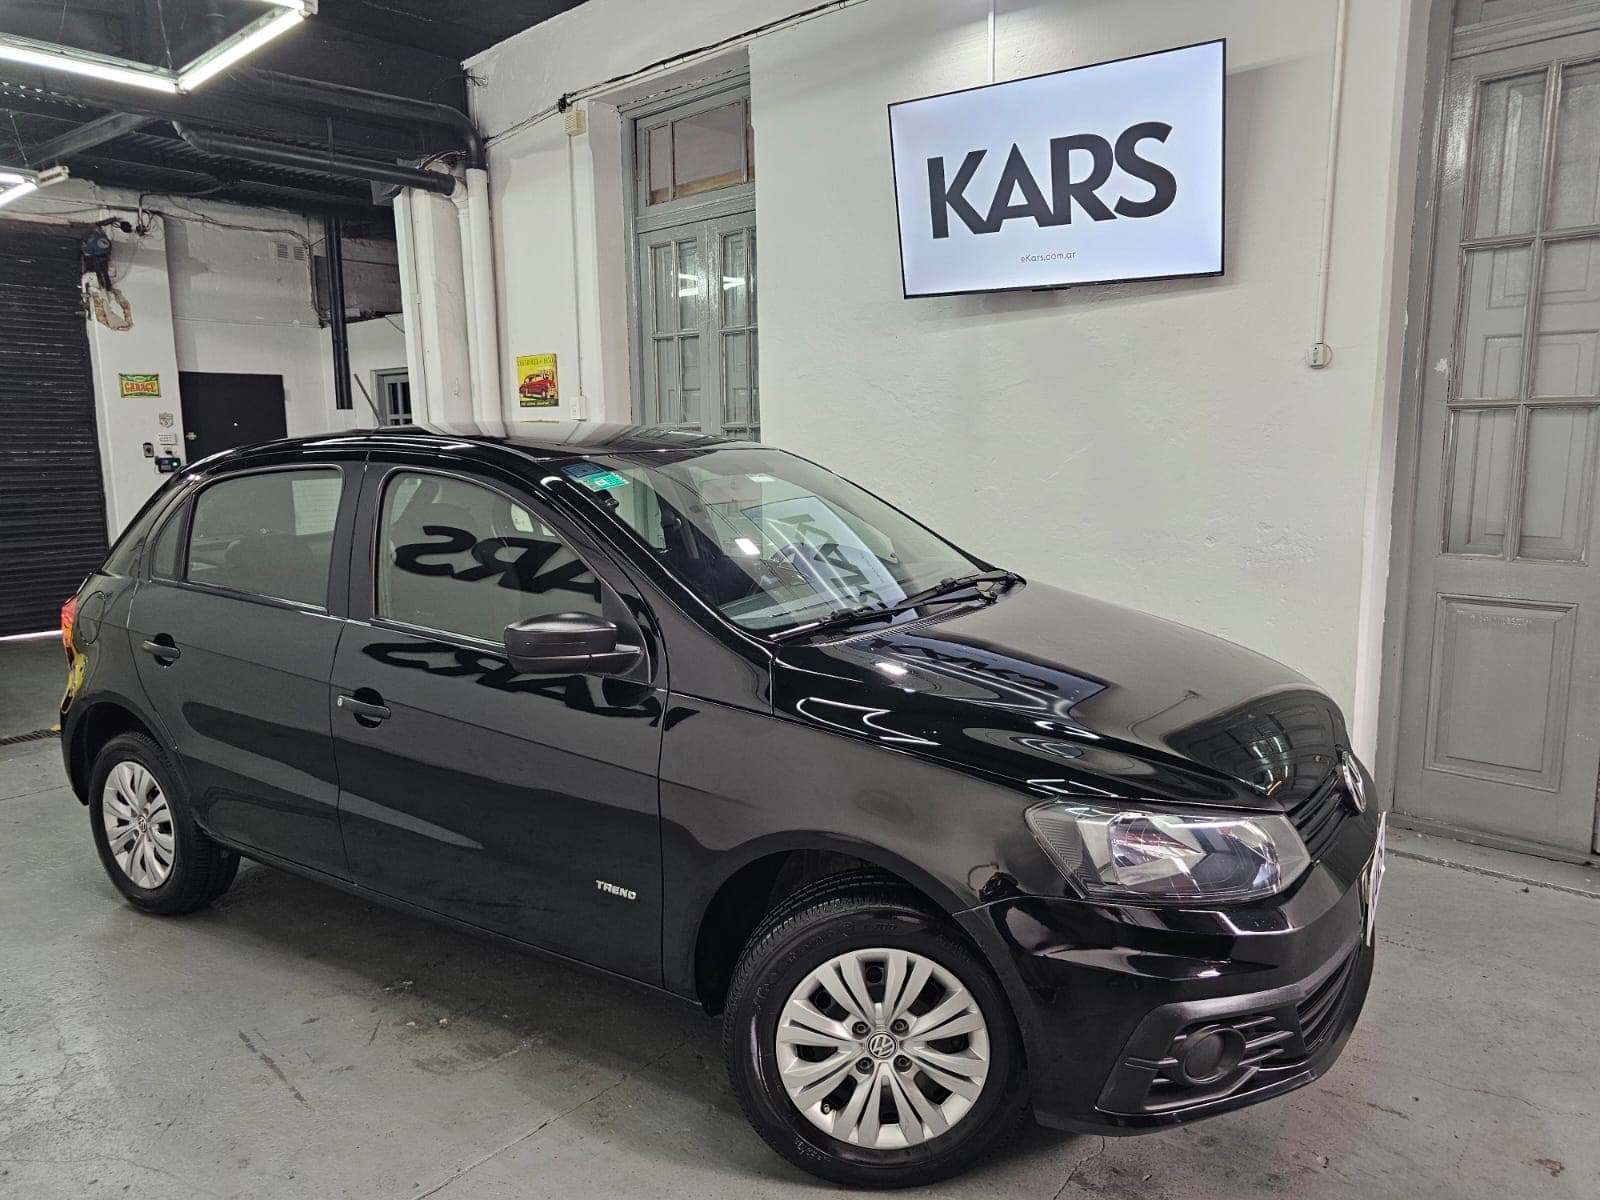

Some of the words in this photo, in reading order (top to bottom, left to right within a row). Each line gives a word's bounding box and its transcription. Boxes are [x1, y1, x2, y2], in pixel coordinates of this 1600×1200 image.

[927, 121, 1177, 239] KARS
[1020, 251, 1076, 262] eKars.com.ar
[595, 879, 637, 900] TREND
